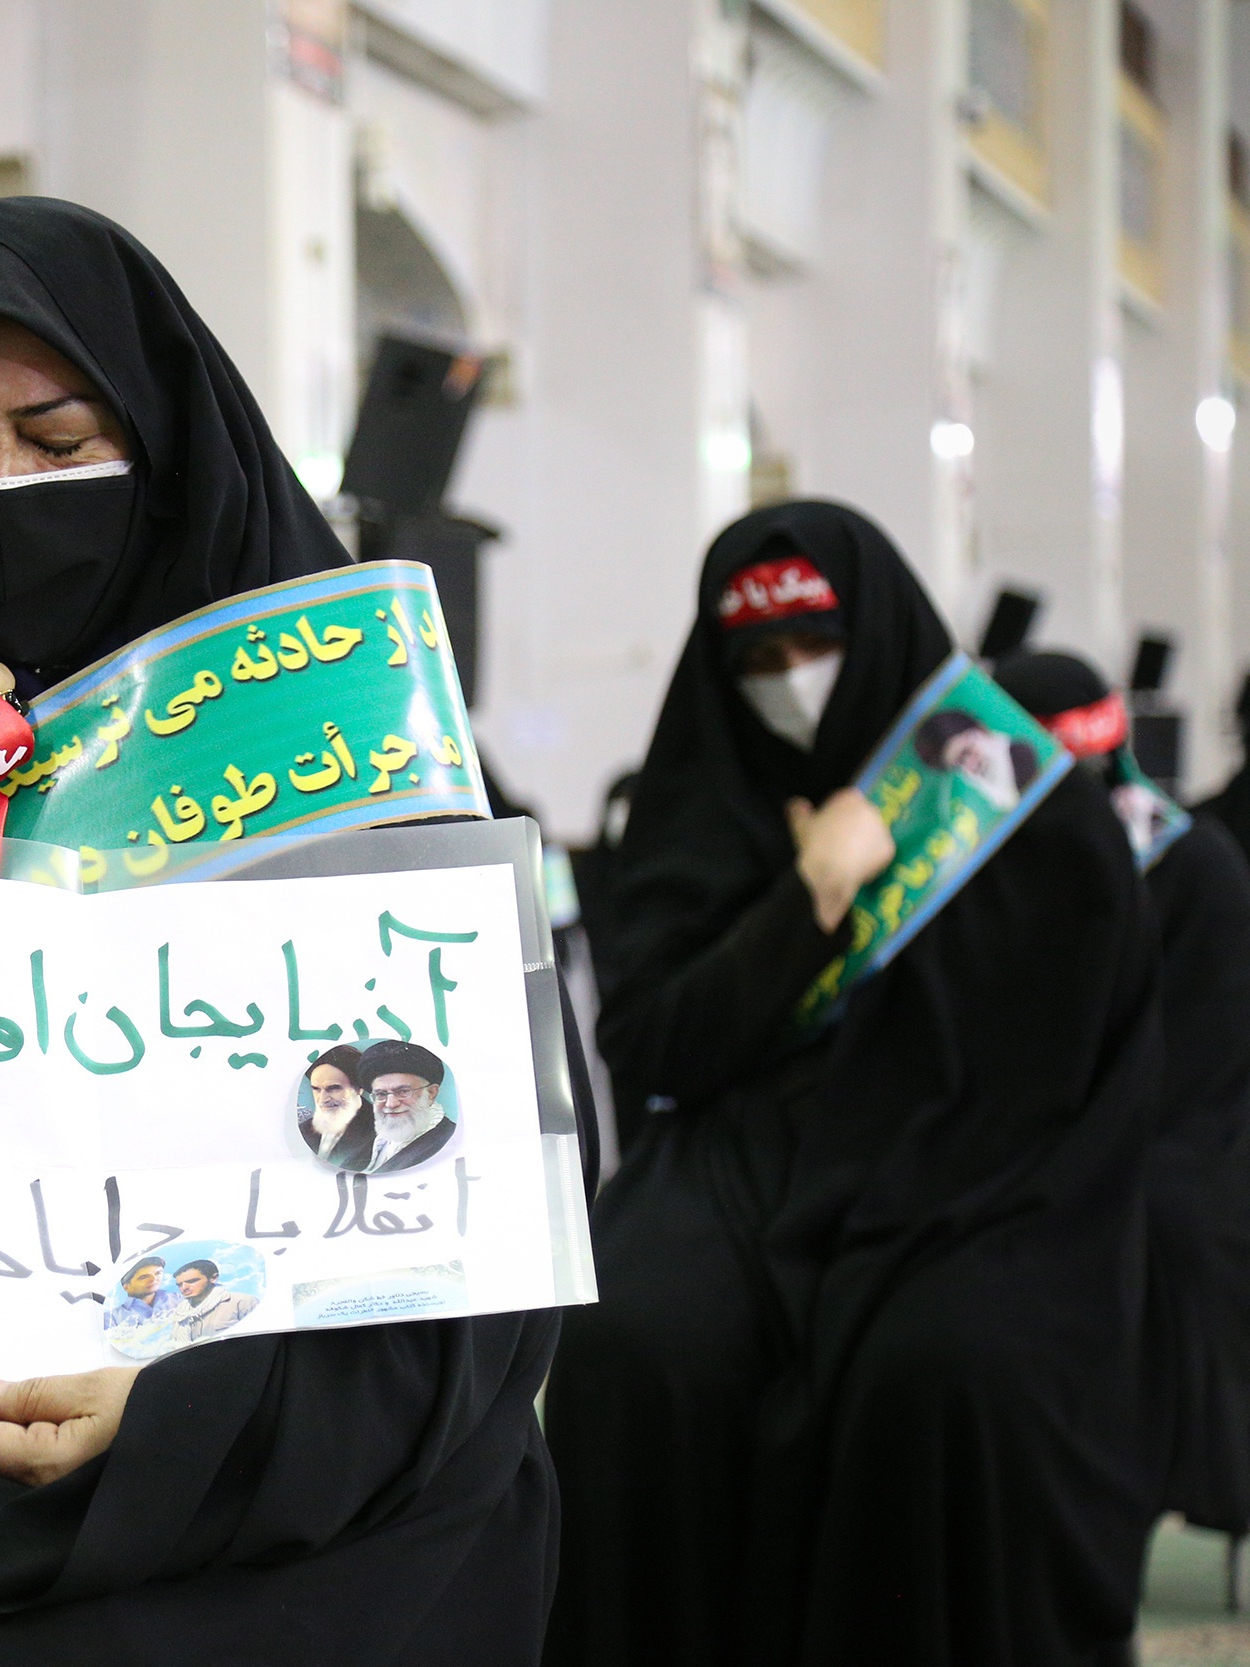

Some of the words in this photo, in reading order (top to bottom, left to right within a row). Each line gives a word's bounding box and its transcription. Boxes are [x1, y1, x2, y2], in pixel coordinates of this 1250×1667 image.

[231, 615, 363, 681] حادثه
[375, 596, 415, 666] از
[145, 670, 223, 736] می
[123, 764, 277, 877] طوفان
